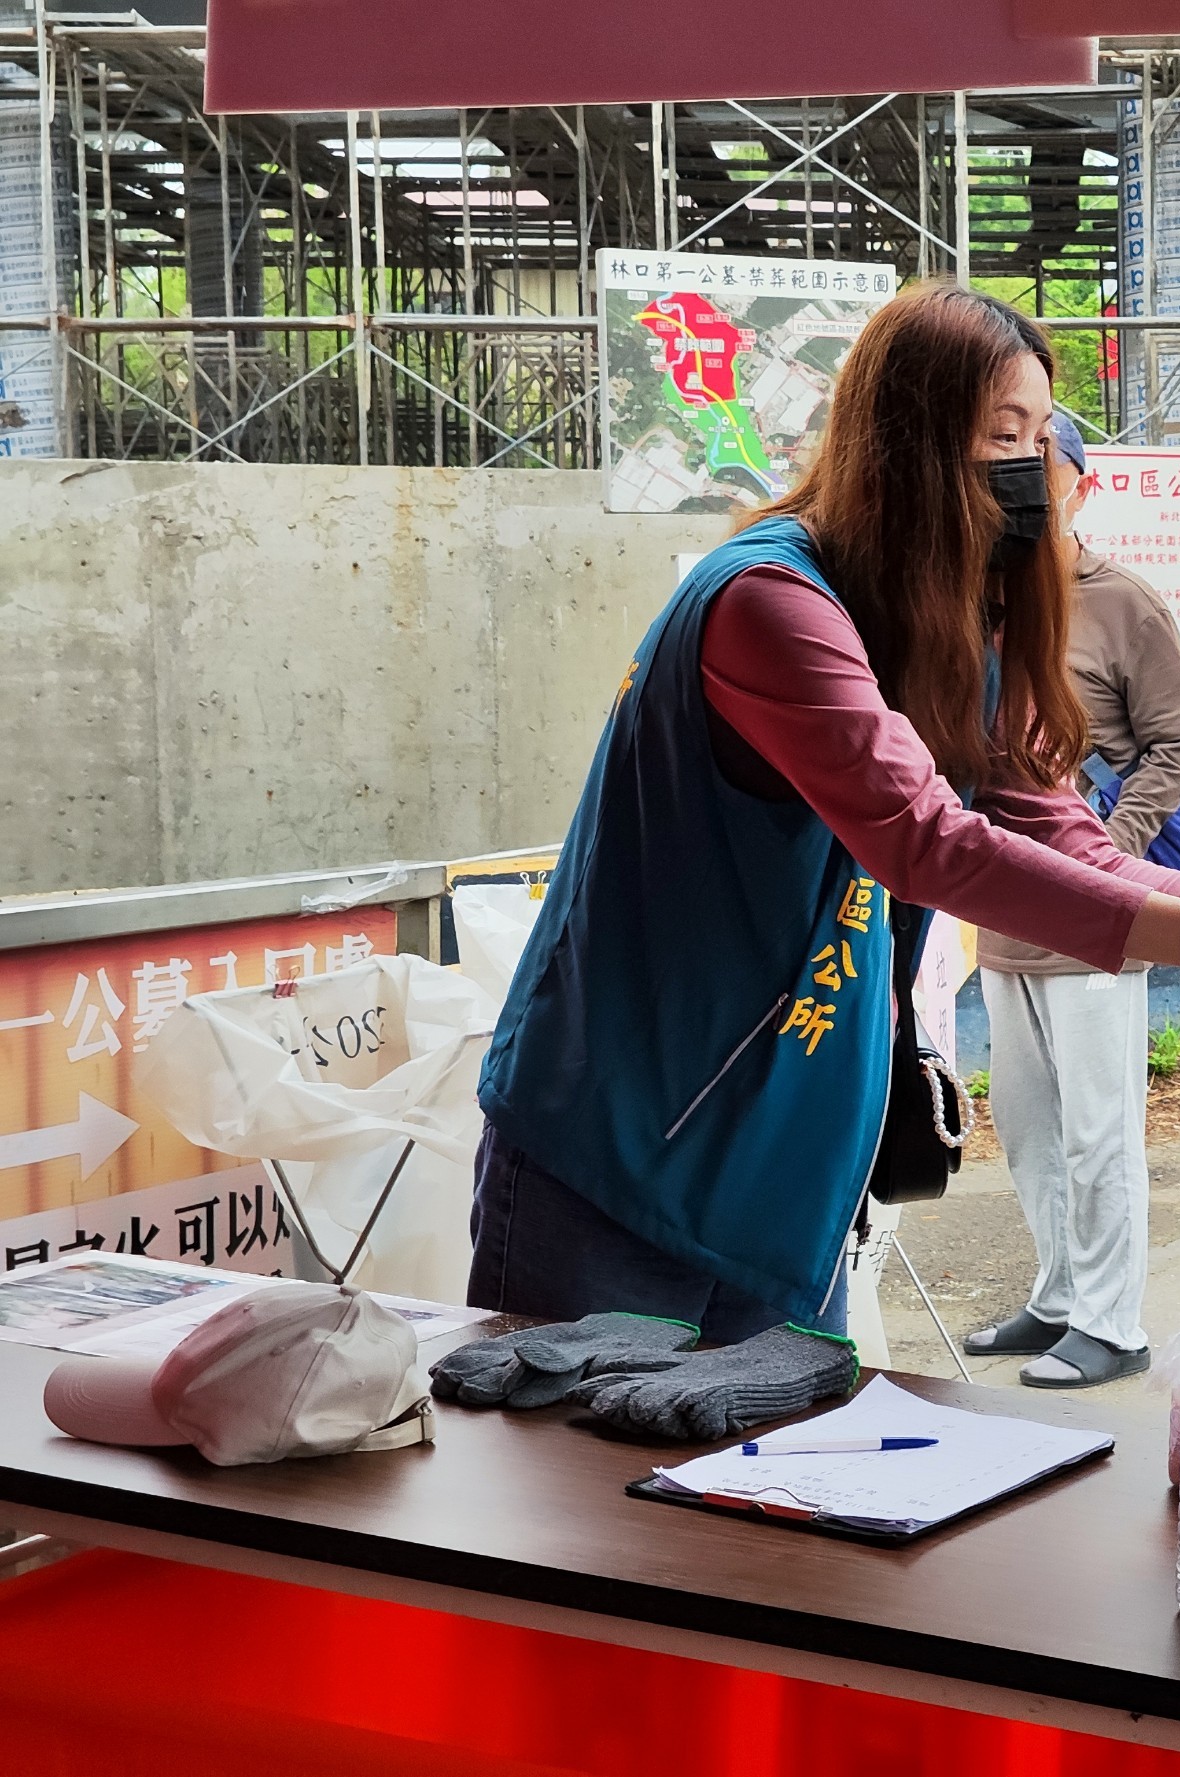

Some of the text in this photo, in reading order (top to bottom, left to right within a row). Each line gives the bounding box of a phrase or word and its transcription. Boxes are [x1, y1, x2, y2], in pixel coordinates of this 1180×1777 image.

[610, 258, 889, 294] 林口第一公墓-禁葬範圍示意圖
[778, 877, 875, 1057] 區公所
